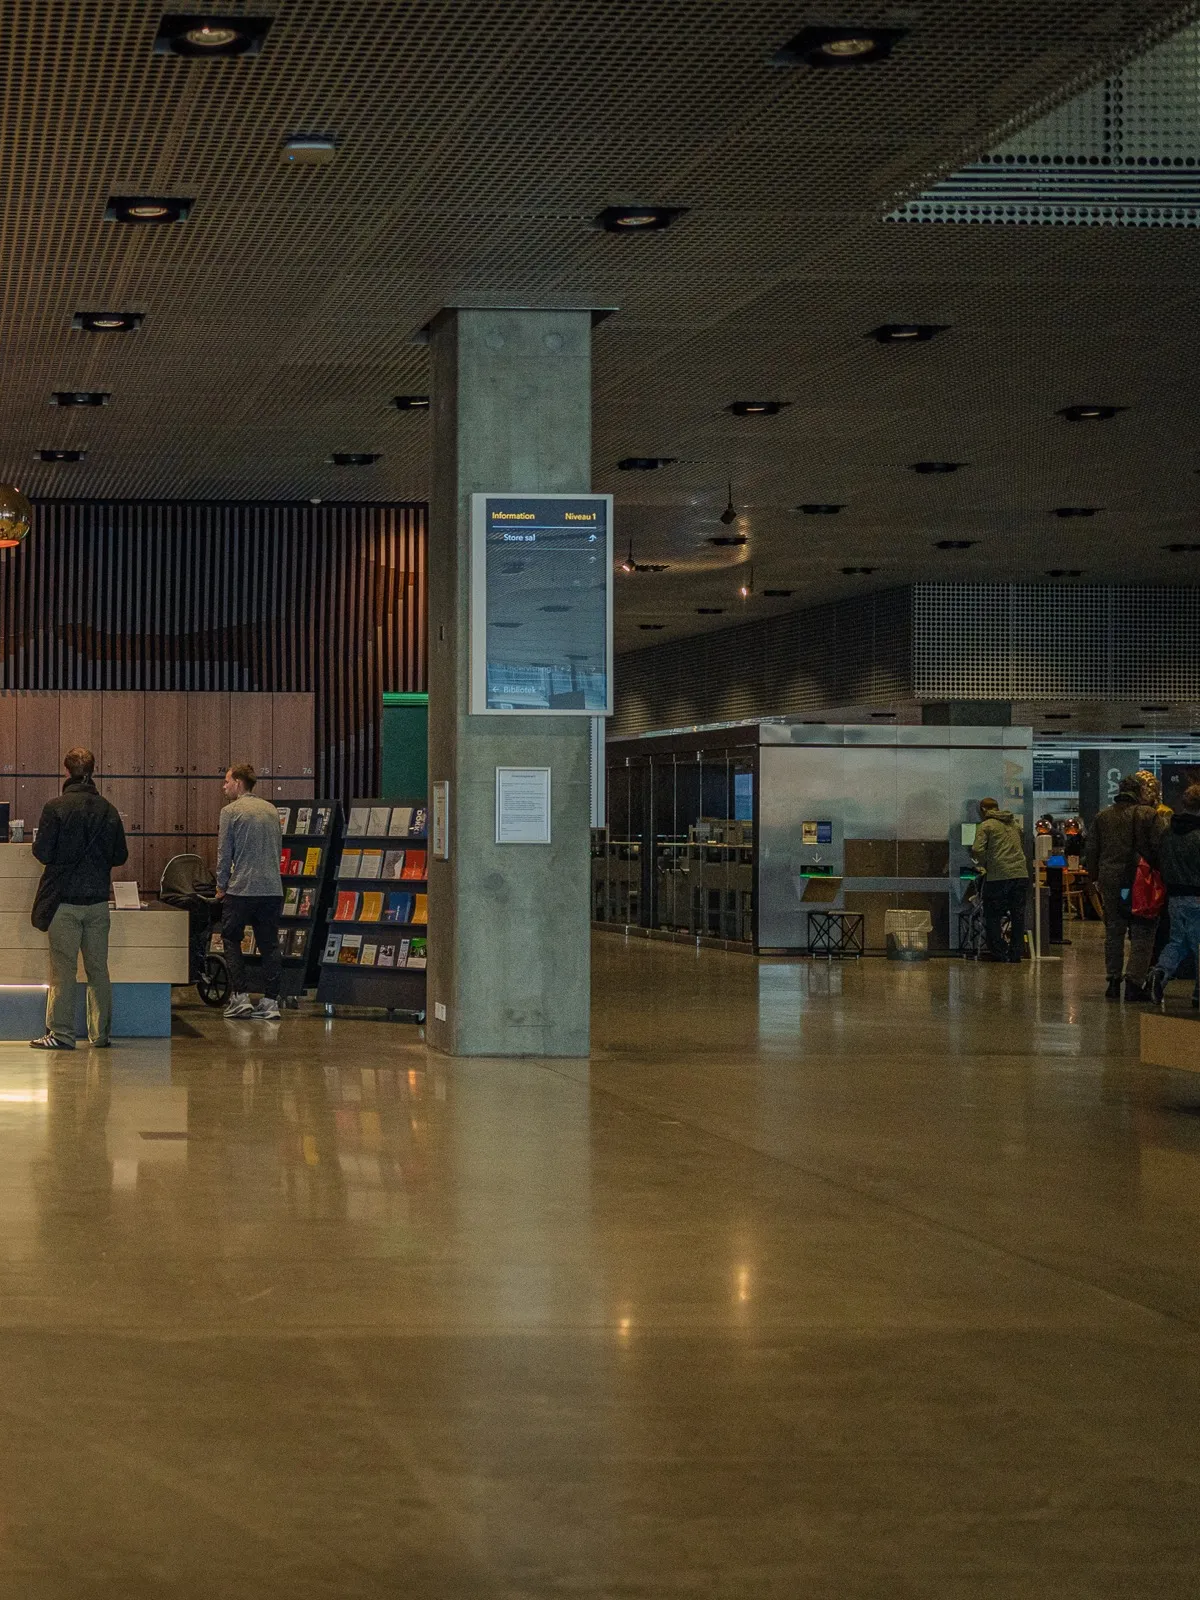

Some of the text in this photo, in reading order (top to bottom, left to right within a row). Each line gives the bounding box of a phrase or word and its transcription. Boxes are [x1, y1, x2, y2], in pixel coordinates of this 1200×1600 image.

[491, 512, 535, 521] Information
[565, 512, 591, 521] Niveau
[524, 534, 536, 542] sal
[503, 686, 537, 694] Bibliotek
[1107, 768, 1122, 807] CAF
